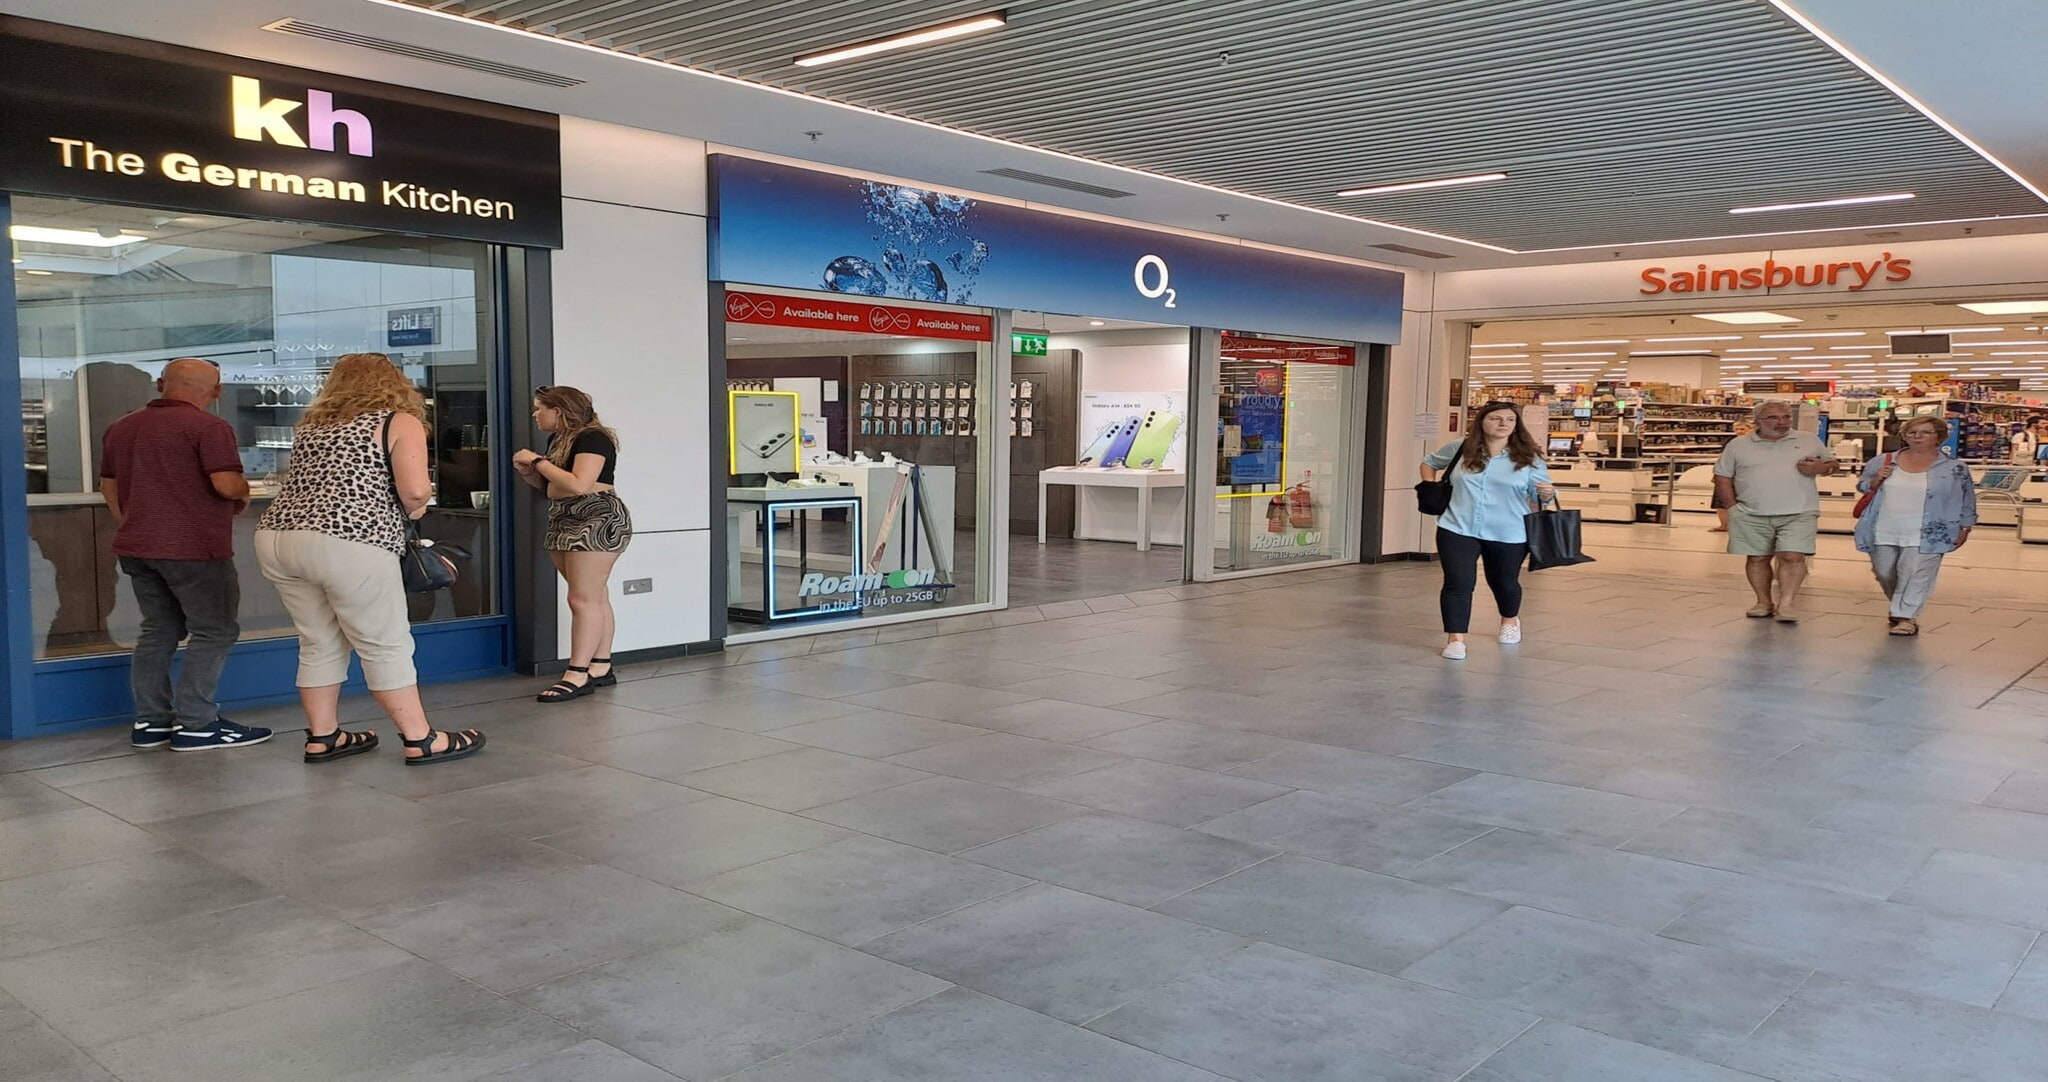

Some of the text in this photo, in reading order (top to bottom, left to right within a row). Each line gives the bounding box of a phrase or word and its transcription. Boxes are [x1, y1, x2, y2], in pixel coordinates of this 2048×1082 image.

[231, 75, 374, 158] kh
[49, 137, 515, 221] The German Kitchen
[1134, 254, 1177, 309] O2
[1640, 252, 1912, 292] Sainsbury's
[783, 306, 860, 322] Available here
[917, 319, 981, 333] Available here
[799, 572, 883, 597] Roam
[819, 591, 933, 612] in the EU up to 25GB
